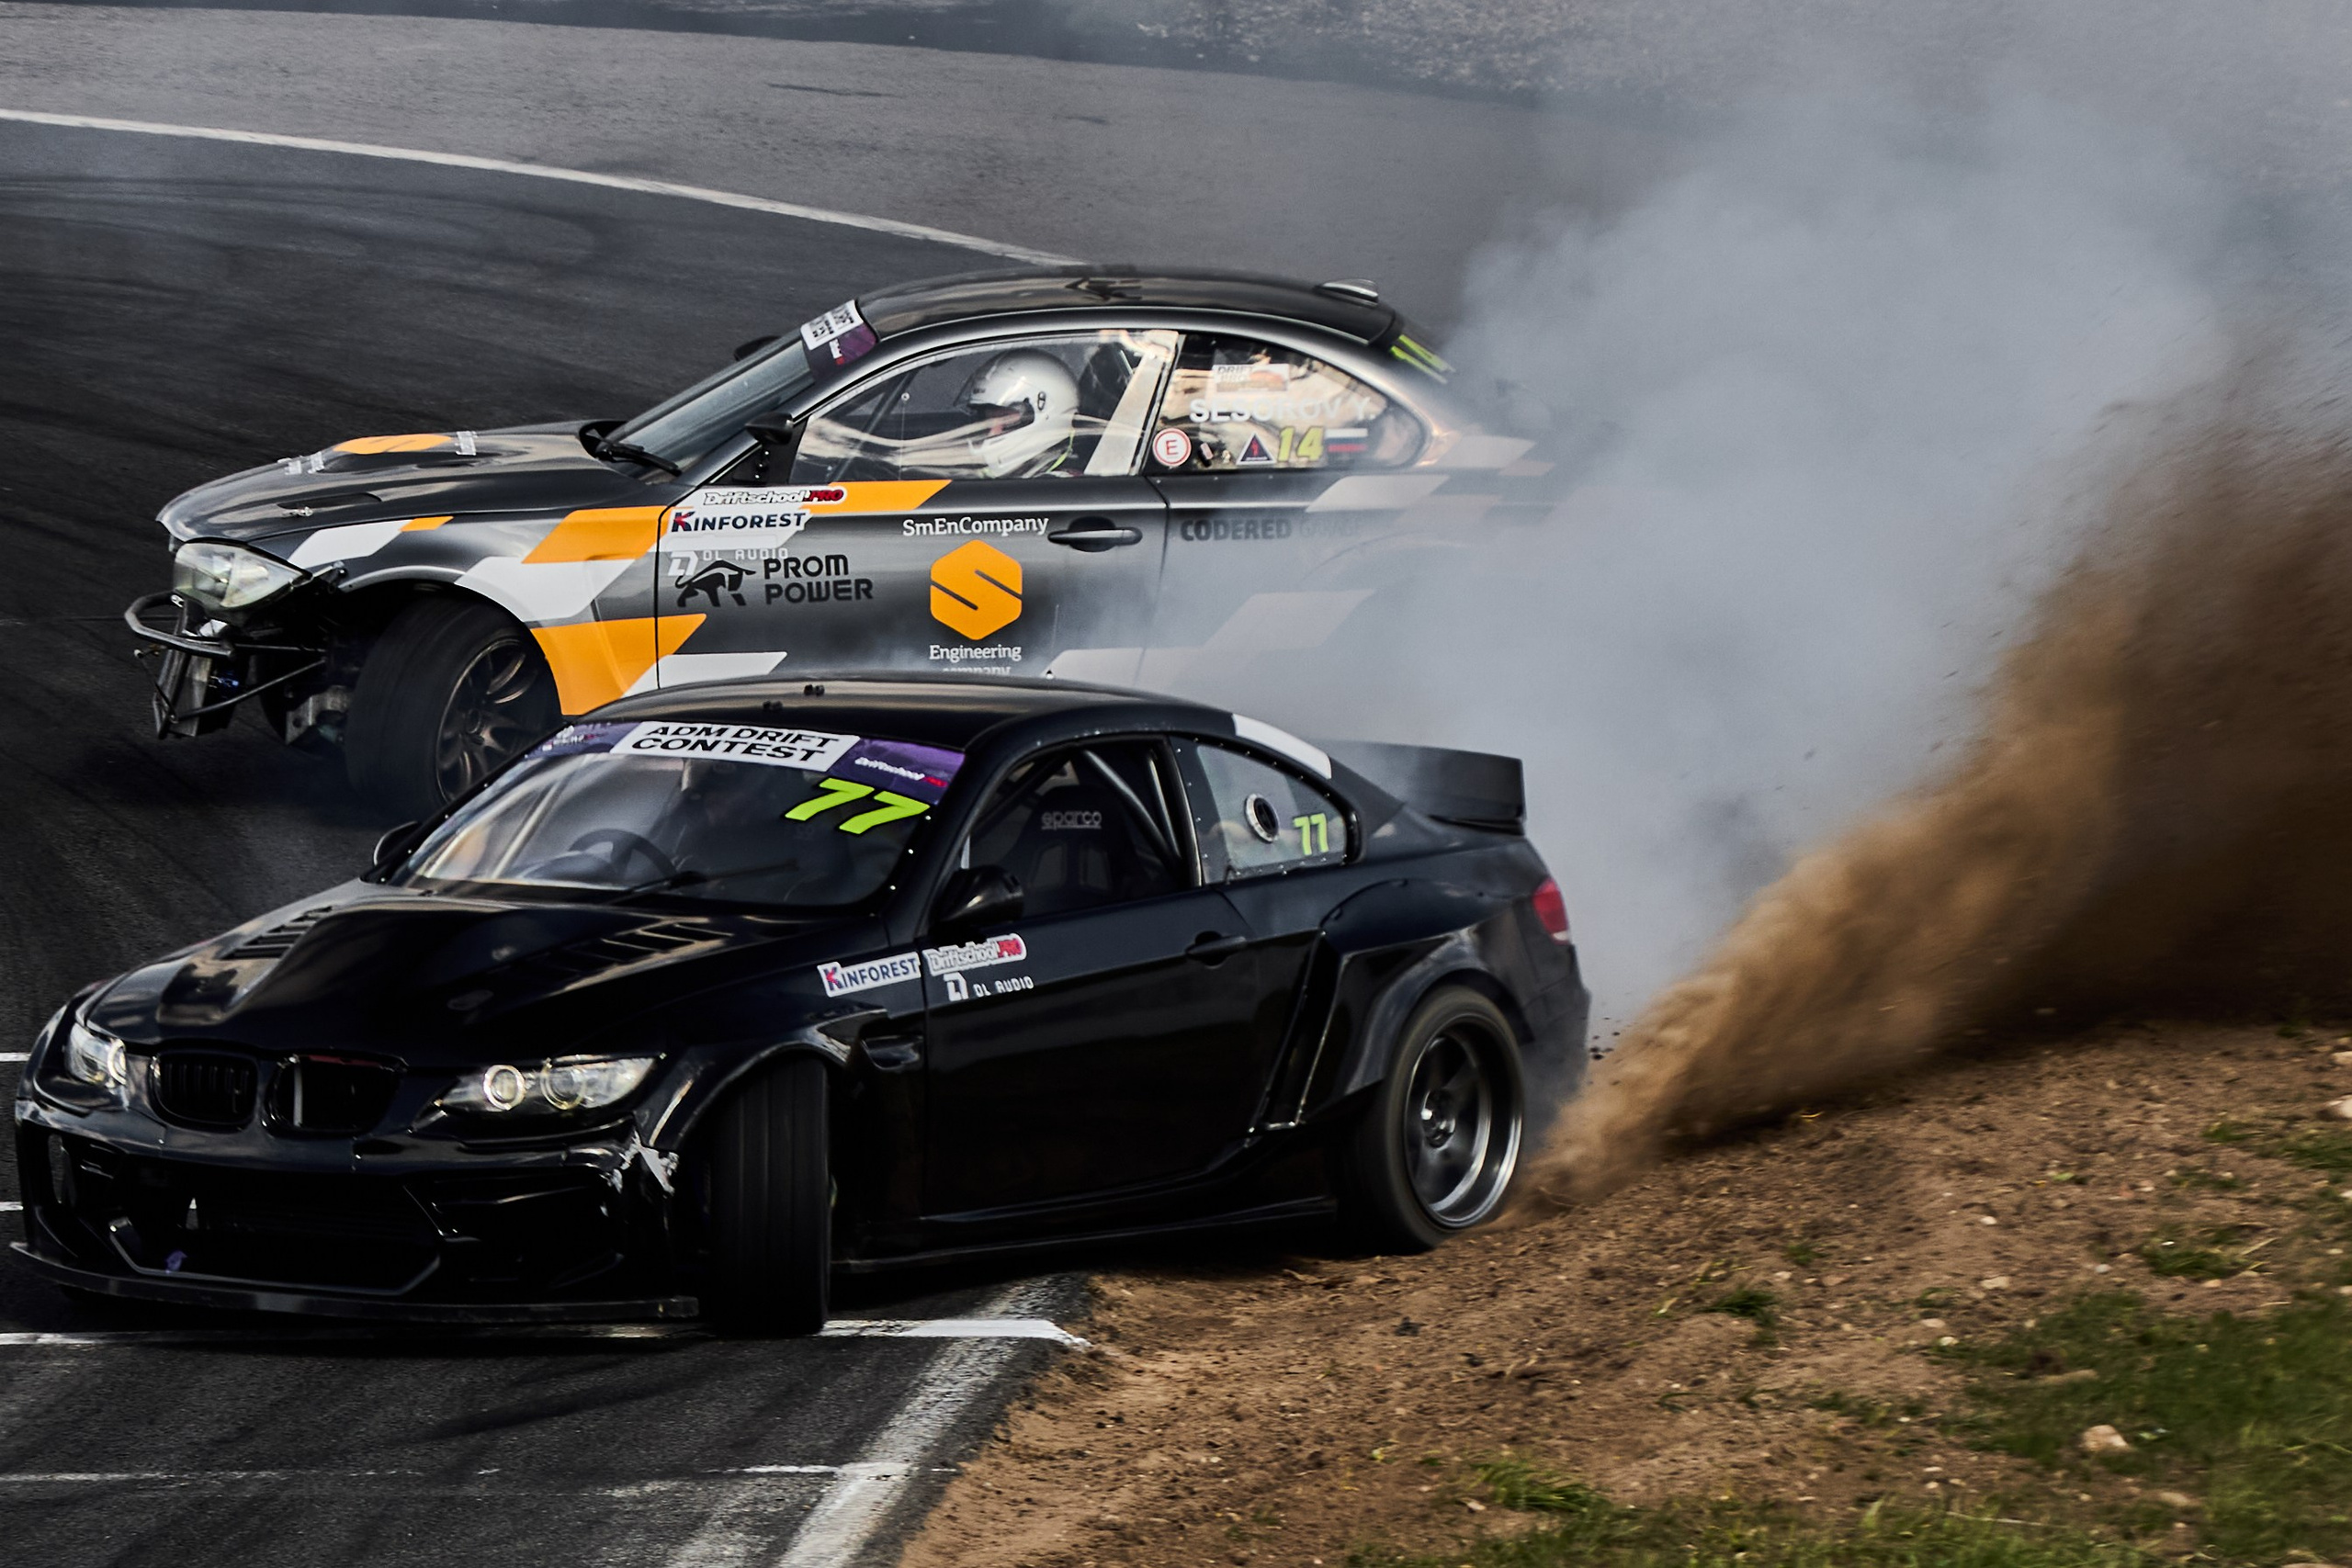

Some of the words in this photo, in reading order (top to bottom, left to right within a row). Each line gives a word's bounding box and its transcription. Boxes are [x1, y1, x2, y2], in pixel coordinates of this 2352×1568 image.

[1165, 439, 1178, 456] E
[1277, 425, 1325, 462] 14
[672, 511, 806, 532] KINFOREST
[902, 517, 1049, 536] SmEnCompany
[1180, 519, 1293, 541] CODERED
[735, 548, 788, 559] AUDIO
[763, 555, 849, 580] PROM
[764, 578, 874, 604] POWER
[929, 644, 1022, 663] Engineering
[647, 726, 728, 738] ADM
[731, 728, 839, 748] DRIFT
[631, 738, 825, 761] CONTEST
[785, 778, 931, 835] 77
[1294, 813, 1329, 855] 77
[823, 958, 918, 991] KINFOREST
[995, 976, 1035, 995] AUDIO
